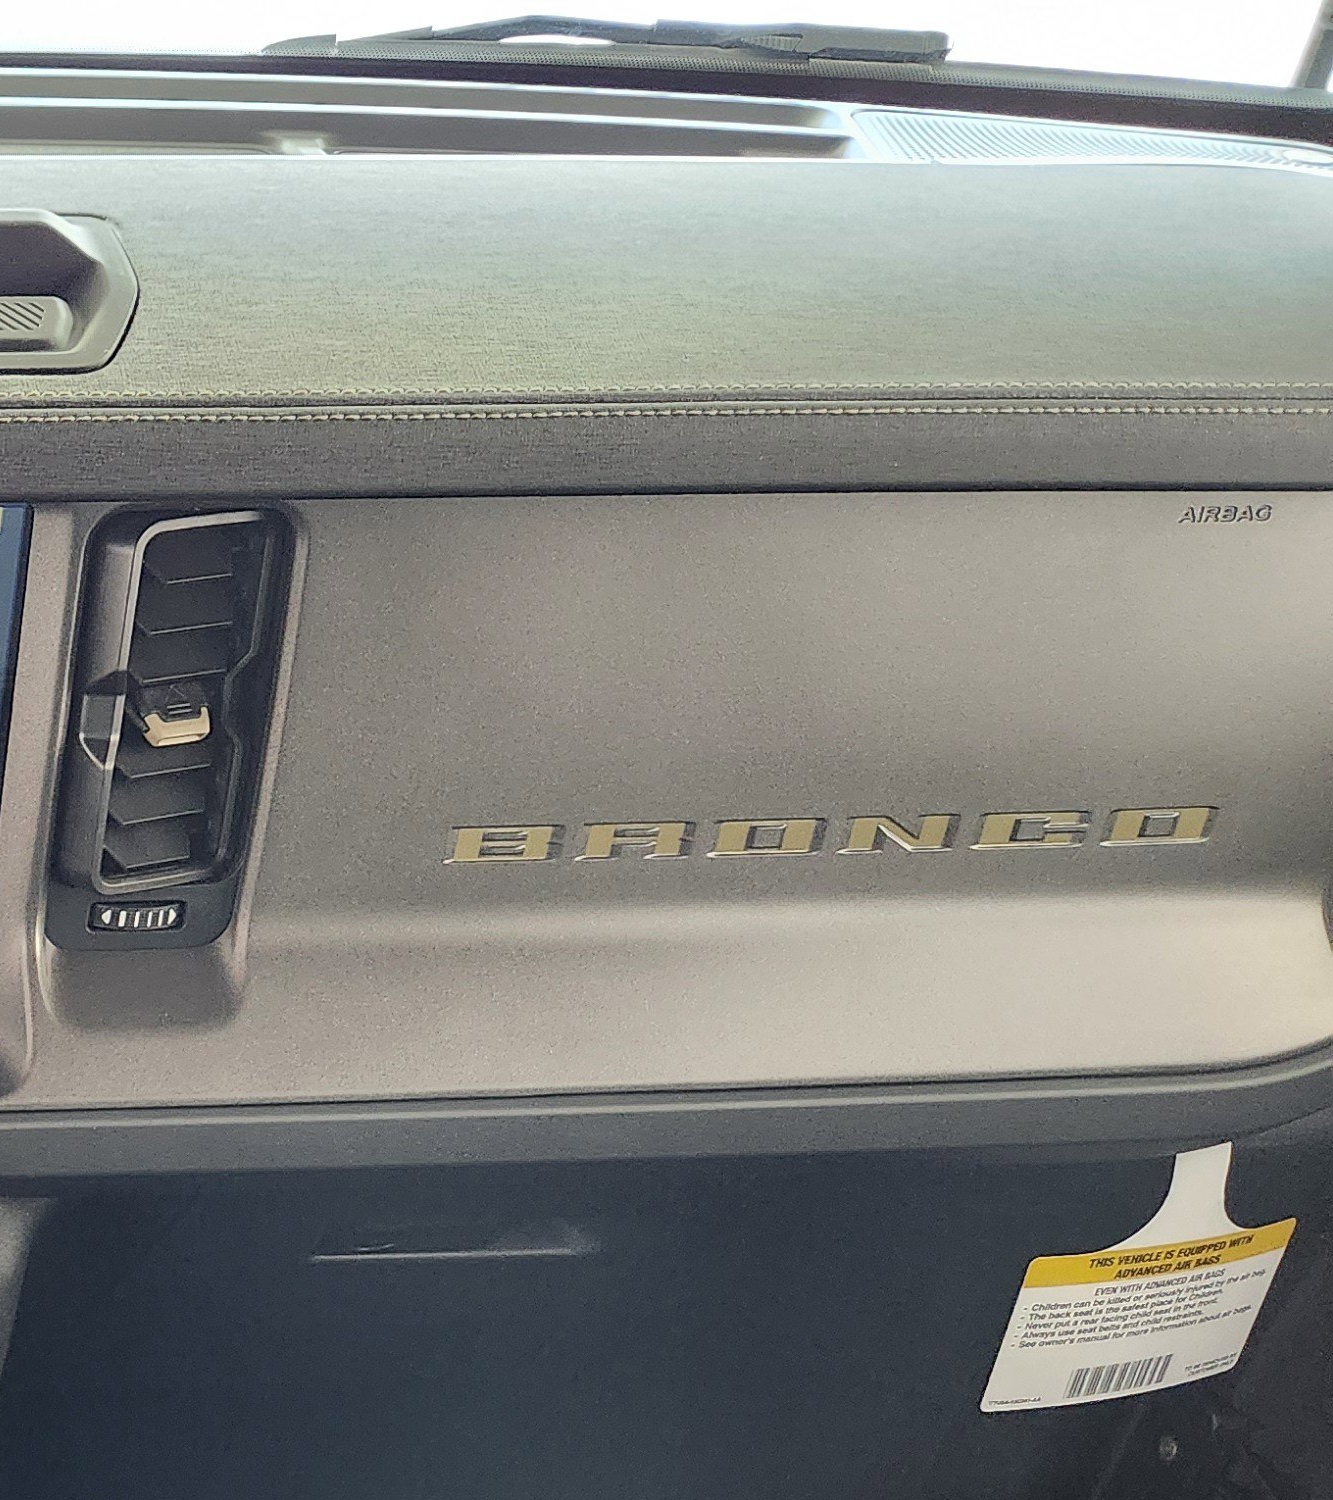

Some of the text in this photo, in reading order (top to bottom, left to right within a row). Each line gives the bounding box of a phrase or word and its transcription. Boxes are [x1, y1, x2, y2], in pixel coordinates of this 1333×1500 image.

[1178, 504, 1273, 523] AIRBAG
[442, 805, 1221, 864] BRONCO
[1089, 1235, 1254, 1268] THIS VEHICLE IS EQUIPPED WITH
[1114, 1263, 1171, 1280] ADVANCED
[1173, 1261, 1192, 1272] AIR
[1094, 1285, 1117, 1296] EVEN
[1119, 1282, 1143, 1294] WITH
[1144, 1276, 1187, 1290] ADVANCED
[1188, 1272, 1204, 1283] AIR
[1031, 1302, 1071, 1311] Children
[1073, 1301, 1091, 1309] can
[1092, 1298, 1105, 1306] be
[1107, 1296, 1131, 1305] killed
[1048, 1310, 1071, 1319] back
[1021, 1330, 1055, 1340] Always
[1025, 1321, 1053, 1330] Never
